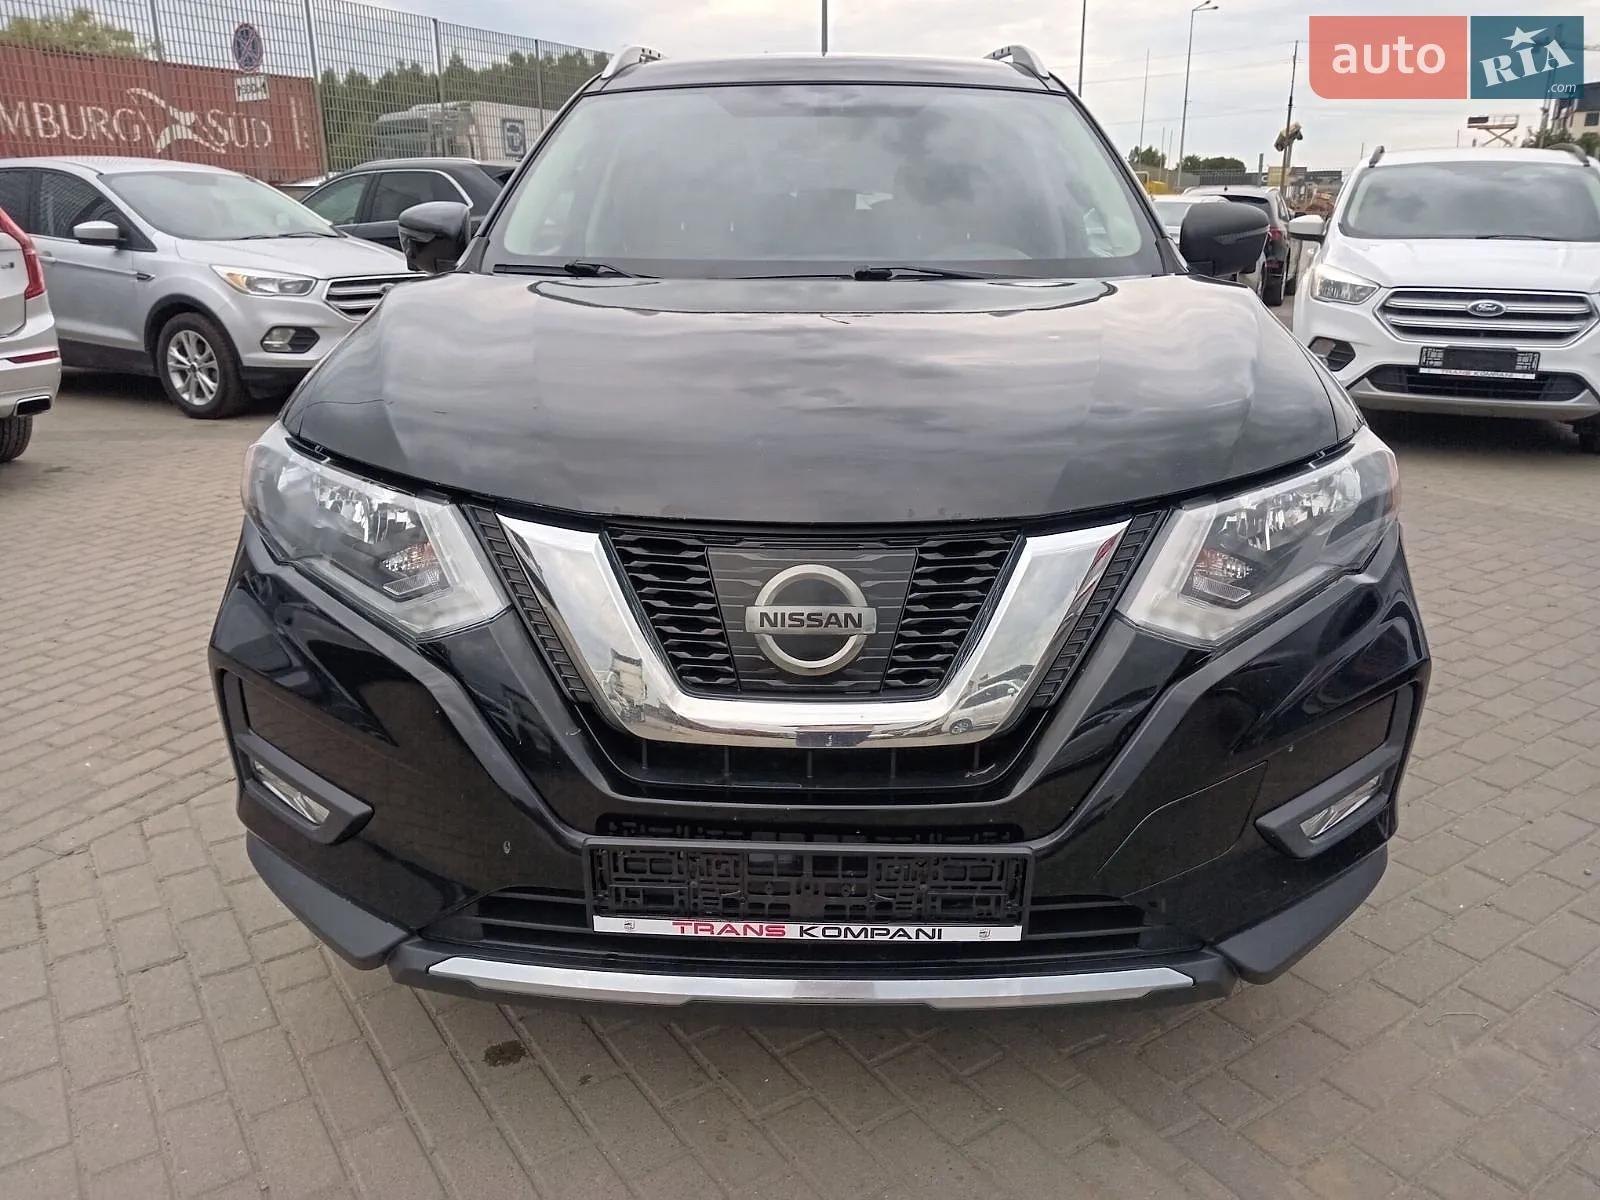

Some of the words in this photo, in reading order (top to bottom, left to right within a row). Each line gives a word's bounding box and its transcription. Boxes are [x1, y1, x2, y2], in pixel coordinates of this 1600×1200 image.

[759, 612, 862, 629] NISSAN
[672, 921, 786, 937] TRANS
[799, 925, 943, 940] KOMPANI
